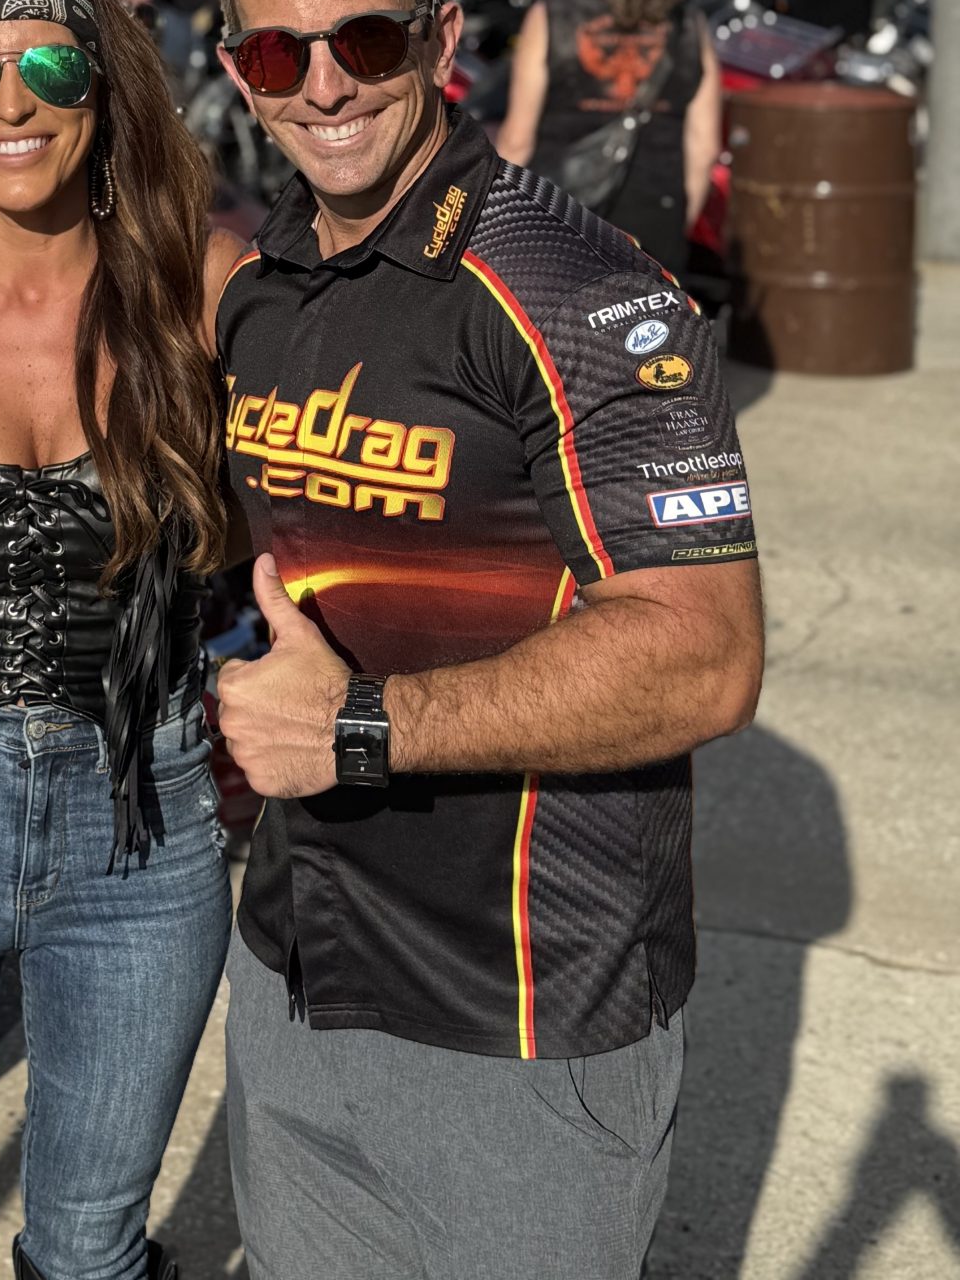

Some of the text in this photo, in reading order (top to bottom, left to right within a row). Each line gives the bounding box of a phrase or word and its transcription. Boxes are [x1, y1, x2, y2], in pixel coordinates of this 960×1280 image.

[665, 416, 709, 431] HAASCH
[669, 407, 699, 421] FRAN
[636, 451, 742, 479] Throttlestop
[245, 462, 446, 521] .com
[662, 486, 749, 521] APE
